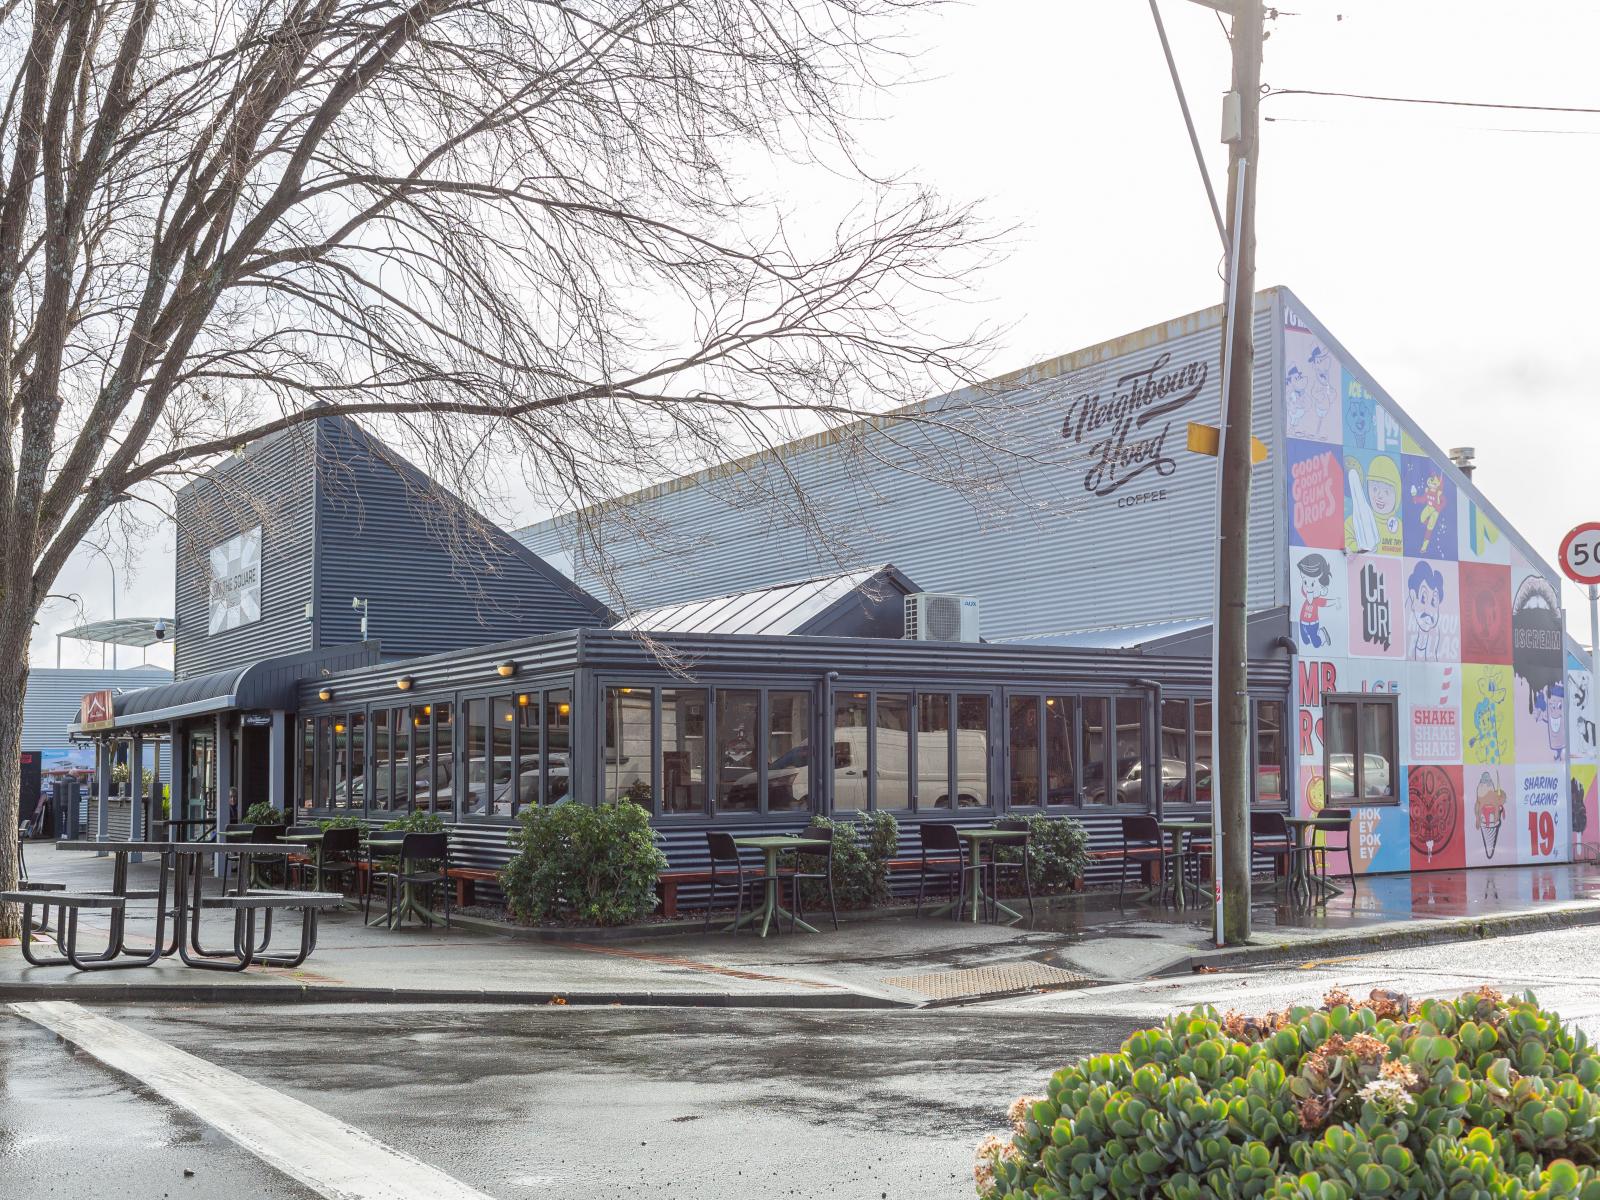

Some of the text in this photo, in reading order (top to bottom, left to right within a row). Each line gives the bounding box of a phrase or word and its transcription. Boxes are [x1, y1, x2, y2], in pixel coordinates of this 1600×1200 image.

[1061, 353, 1208, 443] Neighbour
[1291, 450, 1332, 481] GOODY
[1117, 489, 1167, 508] COFFEE
[234, 567, 256, 590] SQUARE
[1514, 628, 1561, 650] ISCREAM
[1414, 710, 1455, 725] SHAKE
[1415, 726, 1456, 741] SHAKE
[1415, 741, 1456, 757] SHAKE
[1523, 776, 1559, 791] SHARING
[1529, 792, 1559, 807] CARING
[1359, 807, 1381, 820] HOK
[1359, 820, 1374, 833] EY
[1359, 833, 1382, 846] POK
[1359, 846, 1374, 859] EY
